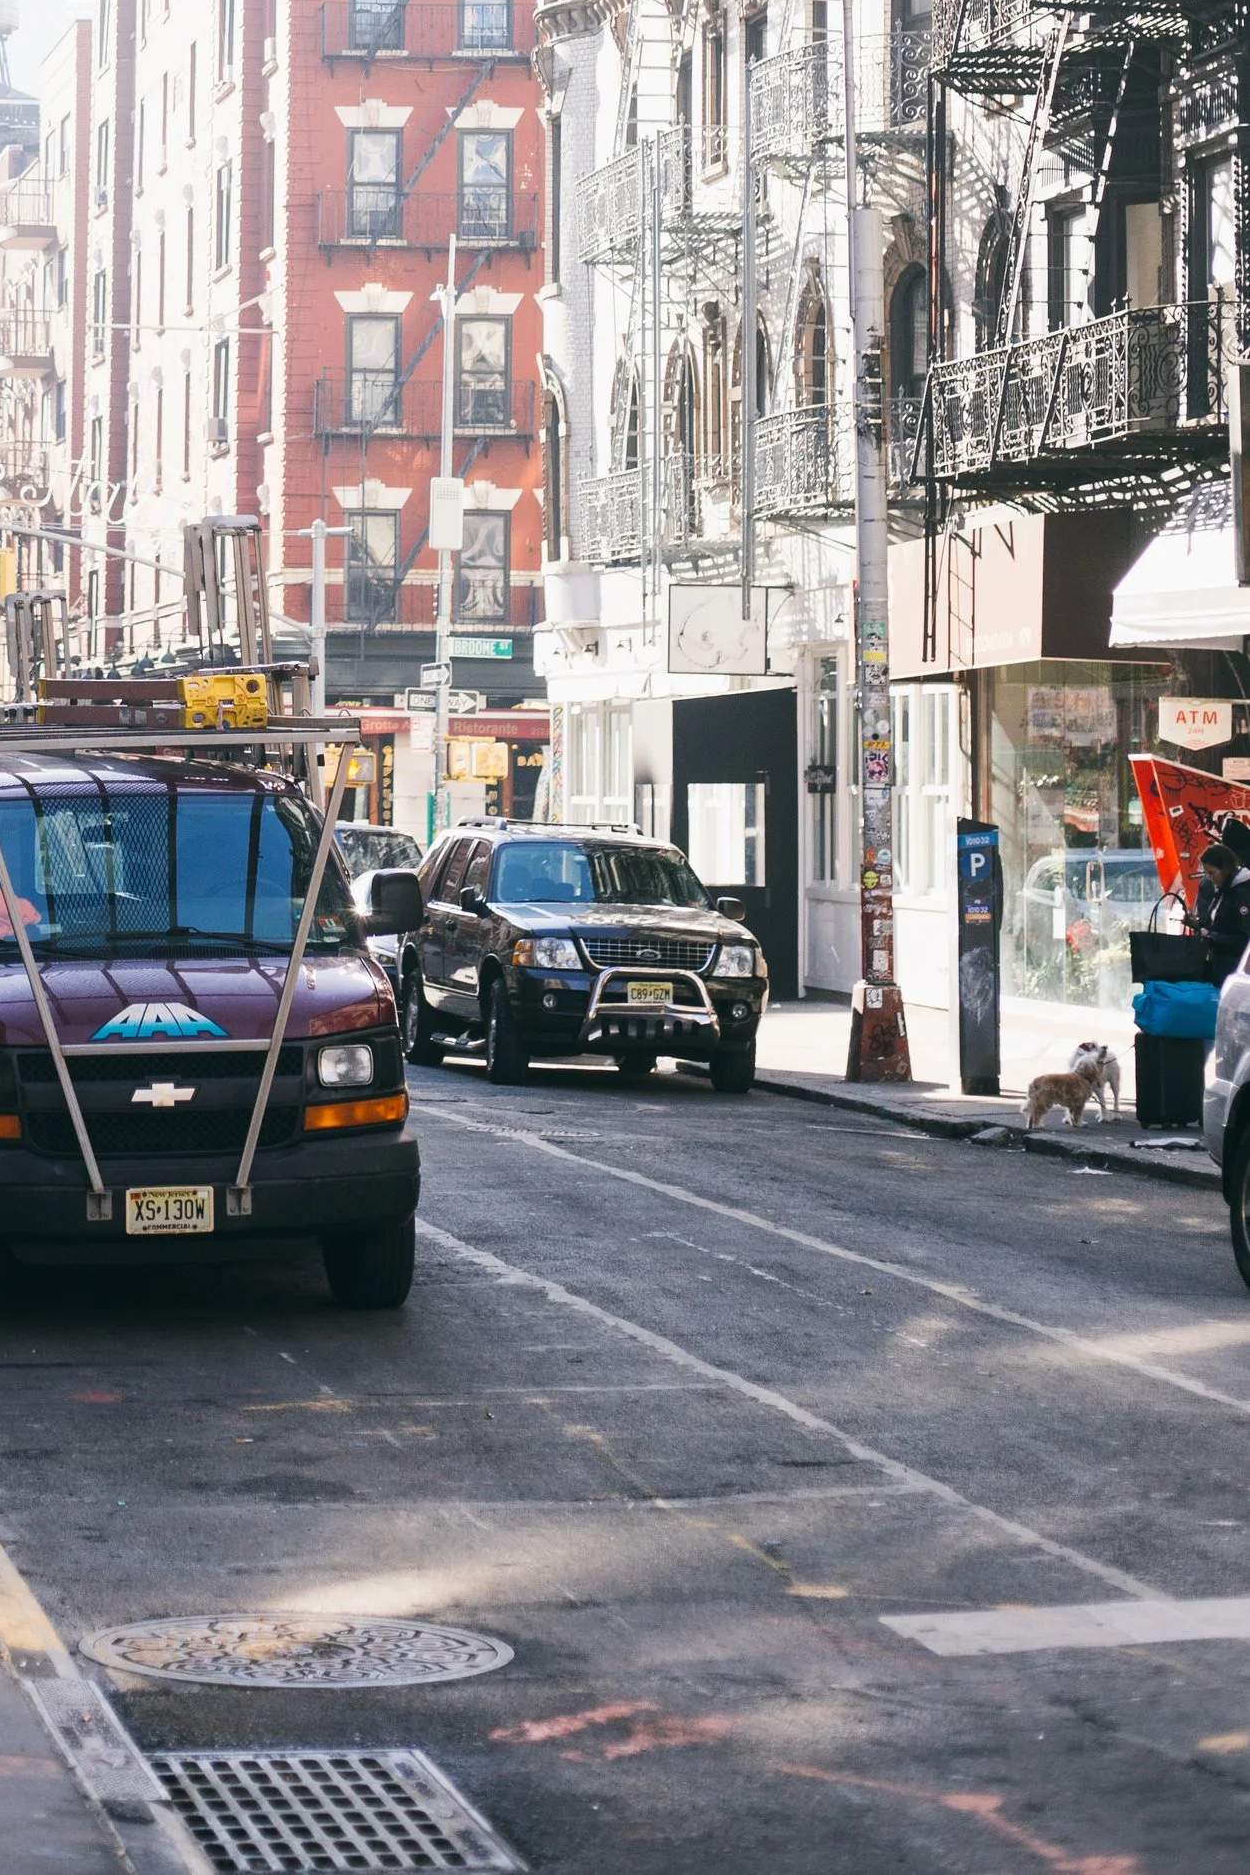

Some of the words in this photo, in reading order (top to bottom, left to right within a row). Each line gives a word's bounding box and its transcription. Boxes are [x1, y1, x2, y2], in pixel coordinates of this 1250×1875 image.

[453, 639, 496, 656] BROOME
[413, 695, 435, 706] ONE
[1175, 710, 1218, 725] ATM
[361, 719, 399, 732] Grotta
[453, 721, 518, 736] Ristorante
[970, 852, 986, 877] P
[89, 1001, 231, 1041] AAA
